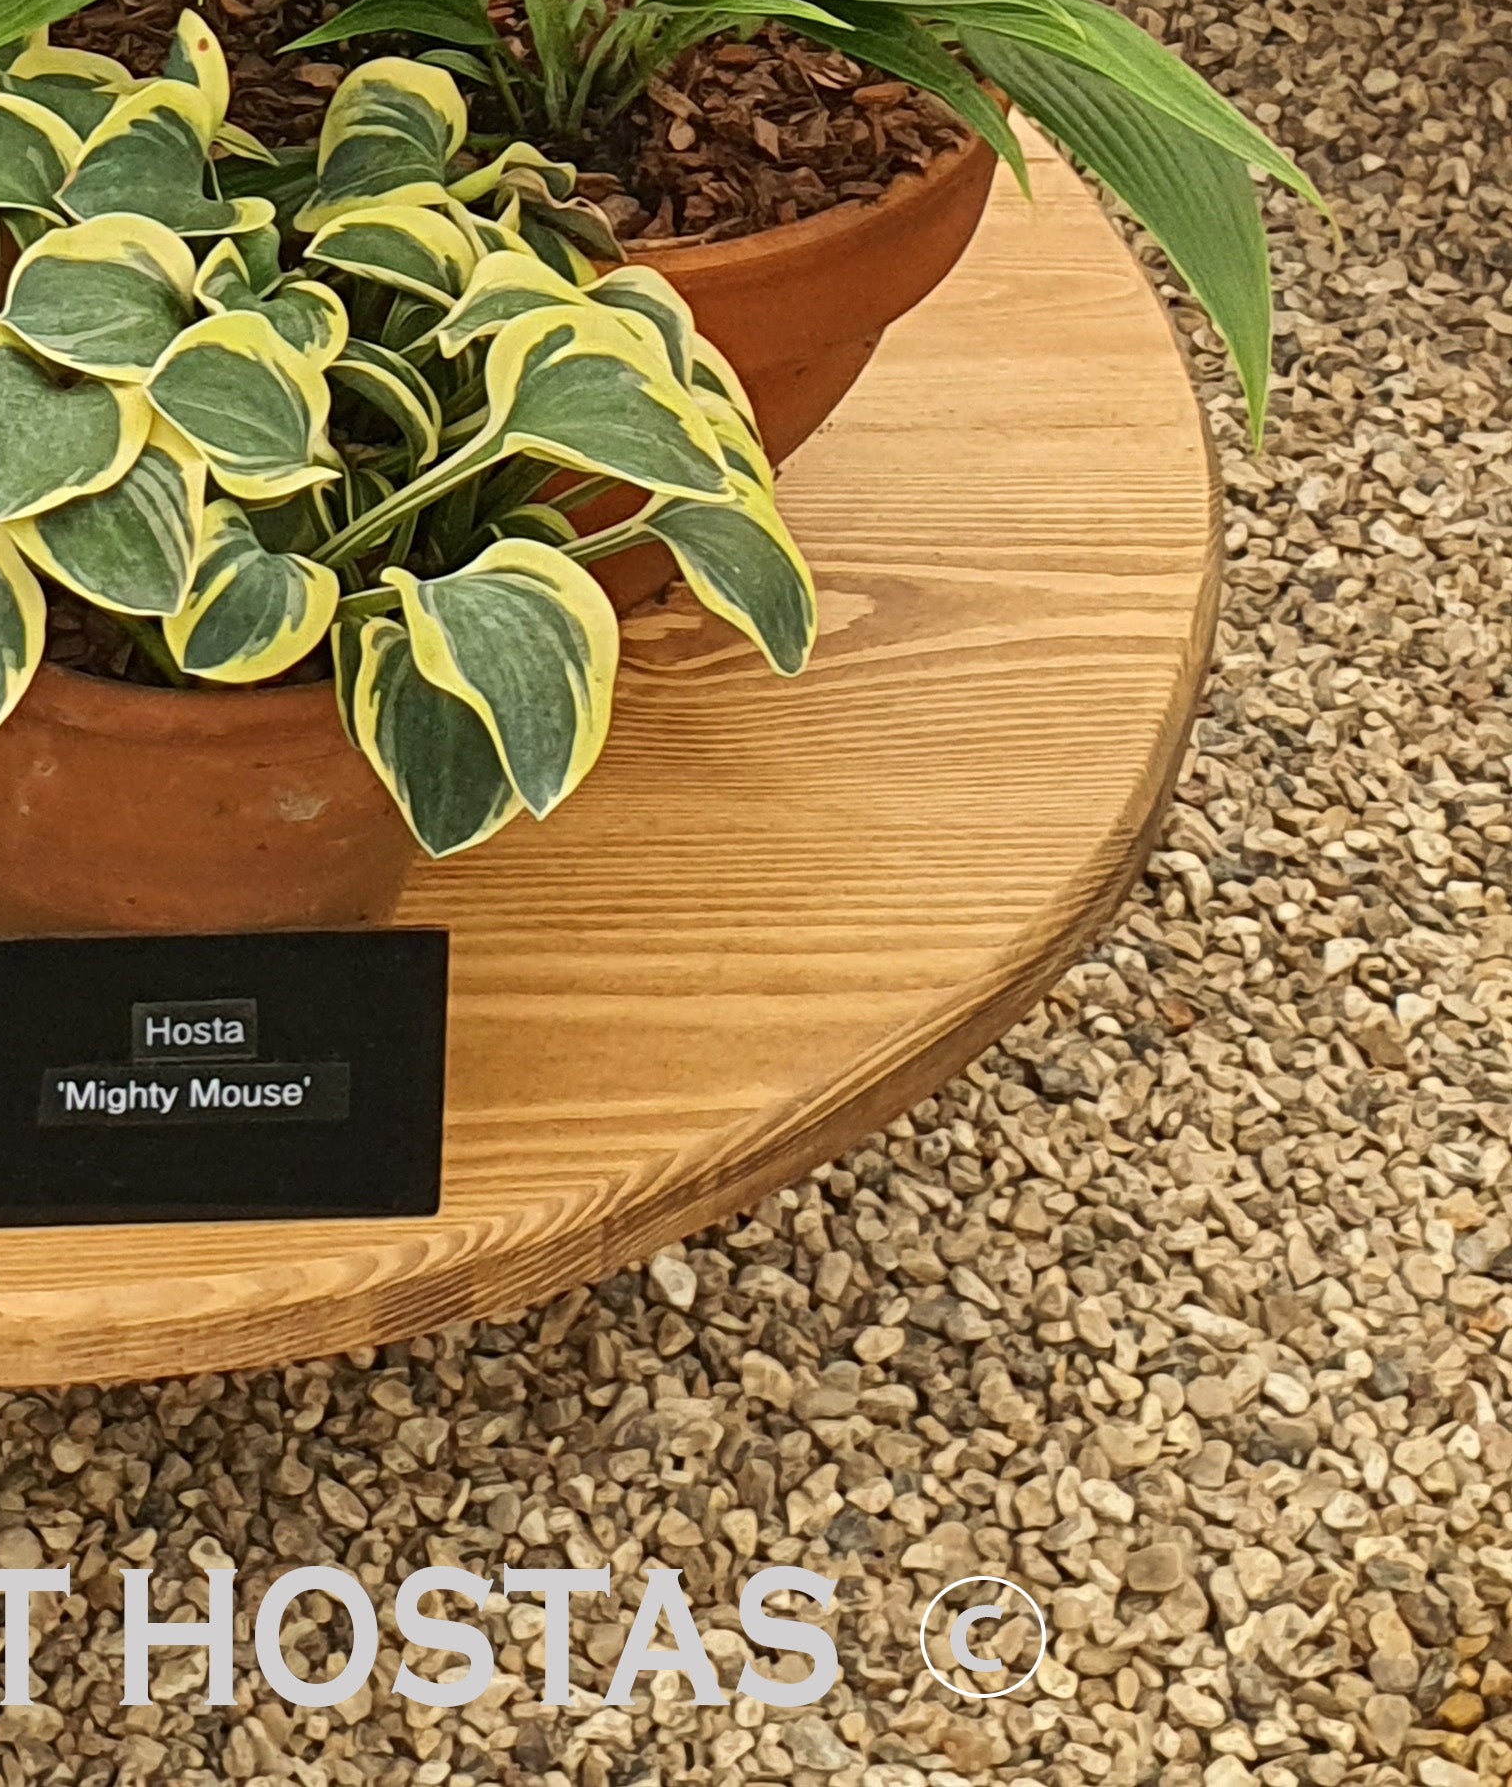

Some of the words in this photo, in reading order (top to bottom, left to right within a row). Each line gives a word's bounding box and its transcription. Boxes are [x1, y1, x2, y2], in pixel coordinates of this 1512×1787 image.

[146, 1016, 245, 1047] Hosta
[57, 1079, 179, 1115] 'Mighty
[190, 1075, 311, 1109] Mouse'
